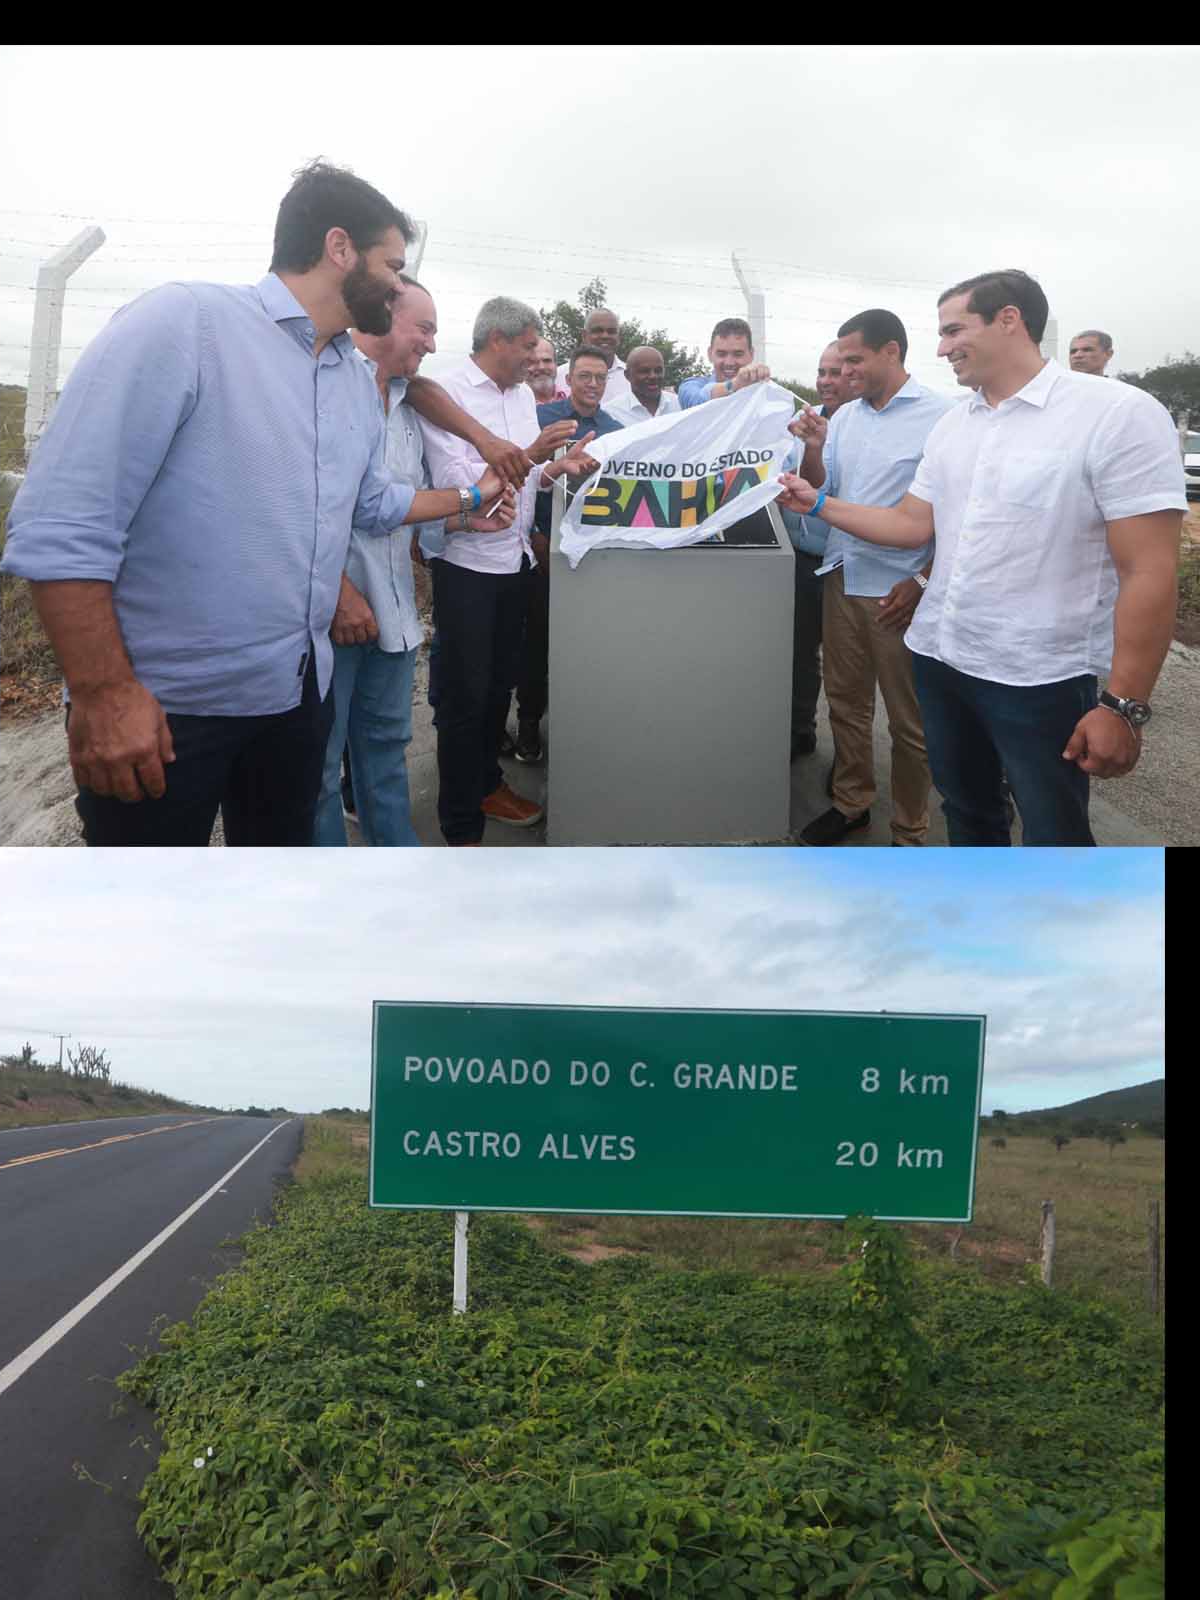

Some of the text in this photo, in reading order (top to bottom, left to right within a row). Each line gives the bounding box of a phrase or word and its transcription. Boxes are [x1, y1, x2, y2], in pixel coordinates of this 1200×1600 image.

[682, 462, 706, 477] DO
[404, 1057, 949, 1095] POVOADO DO C. GRANDE 8 km
[403, 1131, 943, 1168] CASTRO ALVES 20 km
